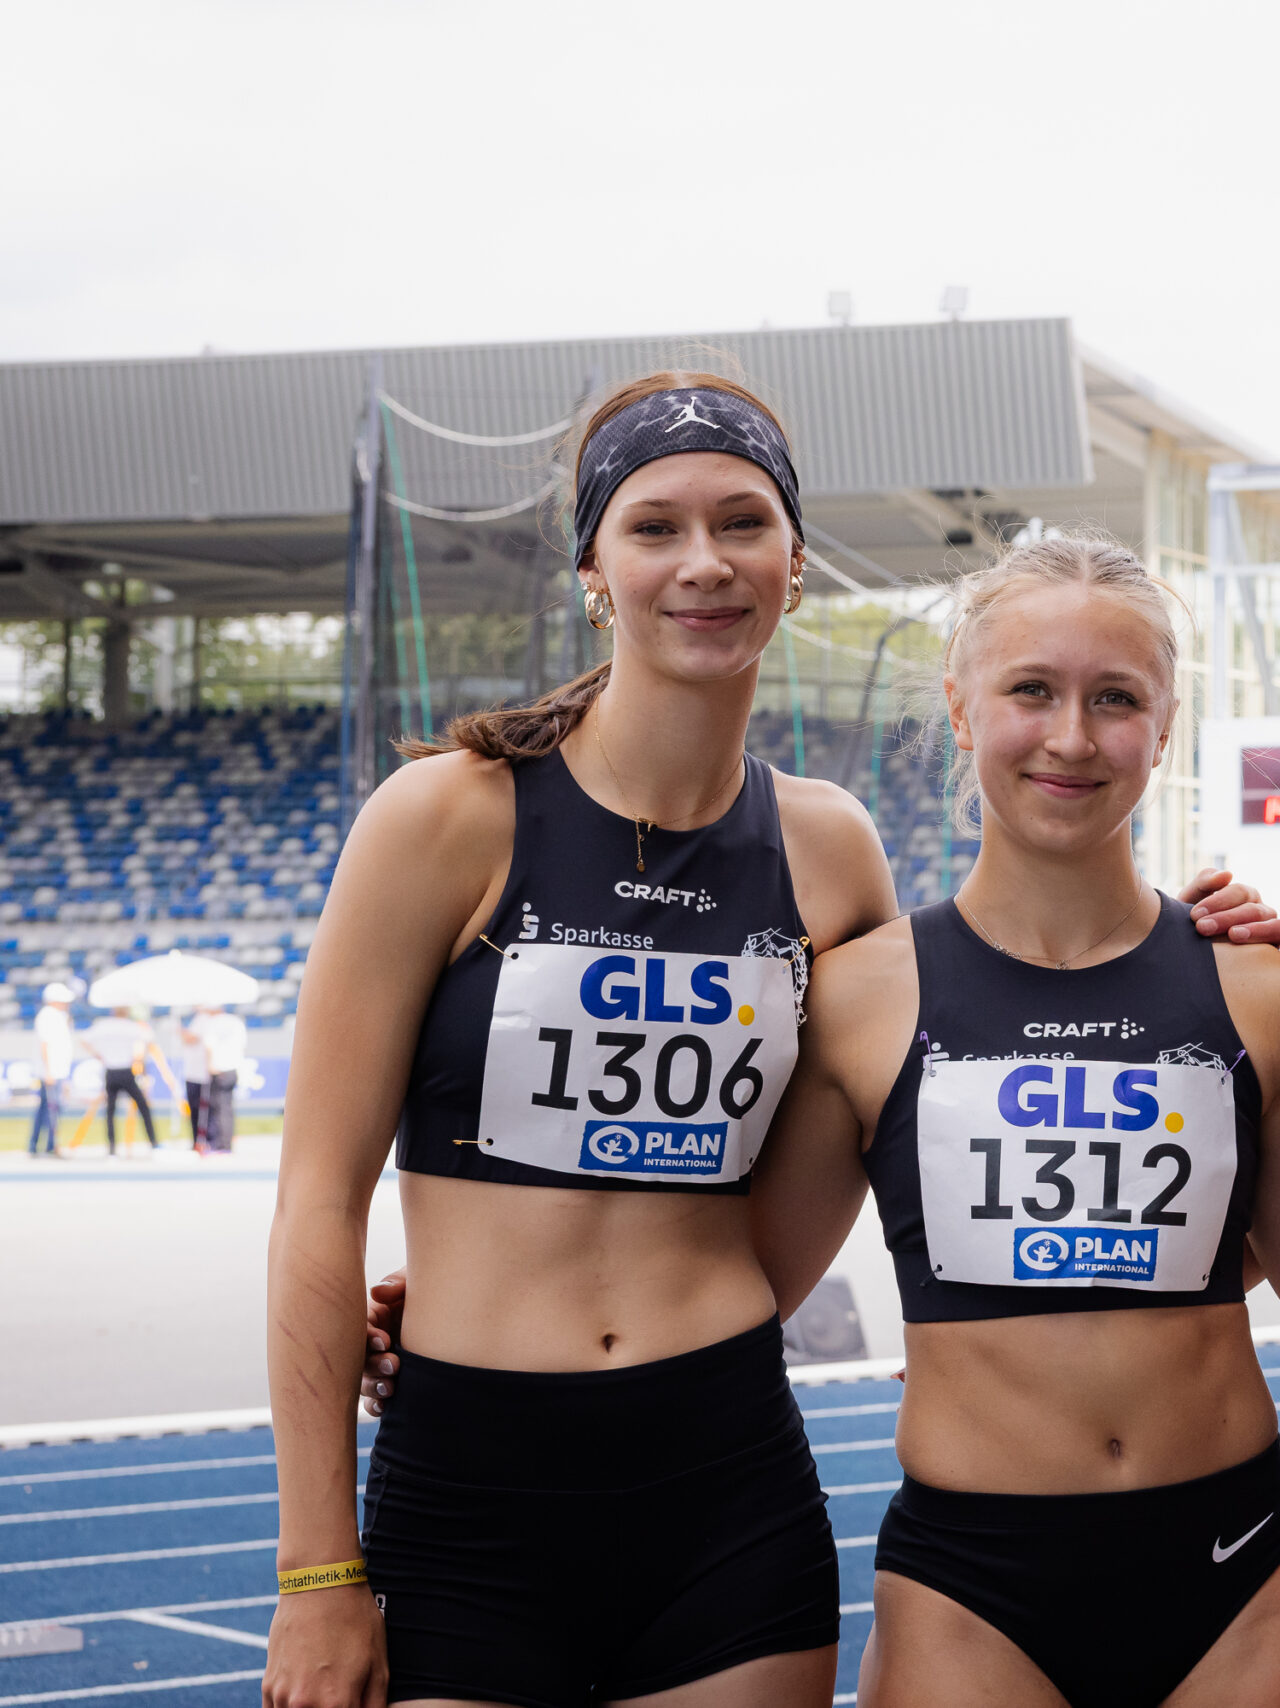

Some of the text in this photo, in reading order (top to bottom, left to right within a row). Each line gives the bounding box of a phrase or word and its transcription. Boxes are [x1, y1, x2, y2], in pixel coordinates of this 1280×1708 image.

[614, 881, 696, 907] CRAFT
[550, 922, 655, 950] Sparkasse
[1023, 1022, 1117, 1038] CRAFT
[531, 1026, 765, 1120] 1306
[644, 1131, 721, 1157] PLAN
[643, 1157, 718, 1168] INTERNATIONAL
[969, 1138, 1192, 1227] 1312
[1074, 1236, 1152, 1263] PLAN
[1074, 1262, 1150, 1275] INTERNATIONAL
